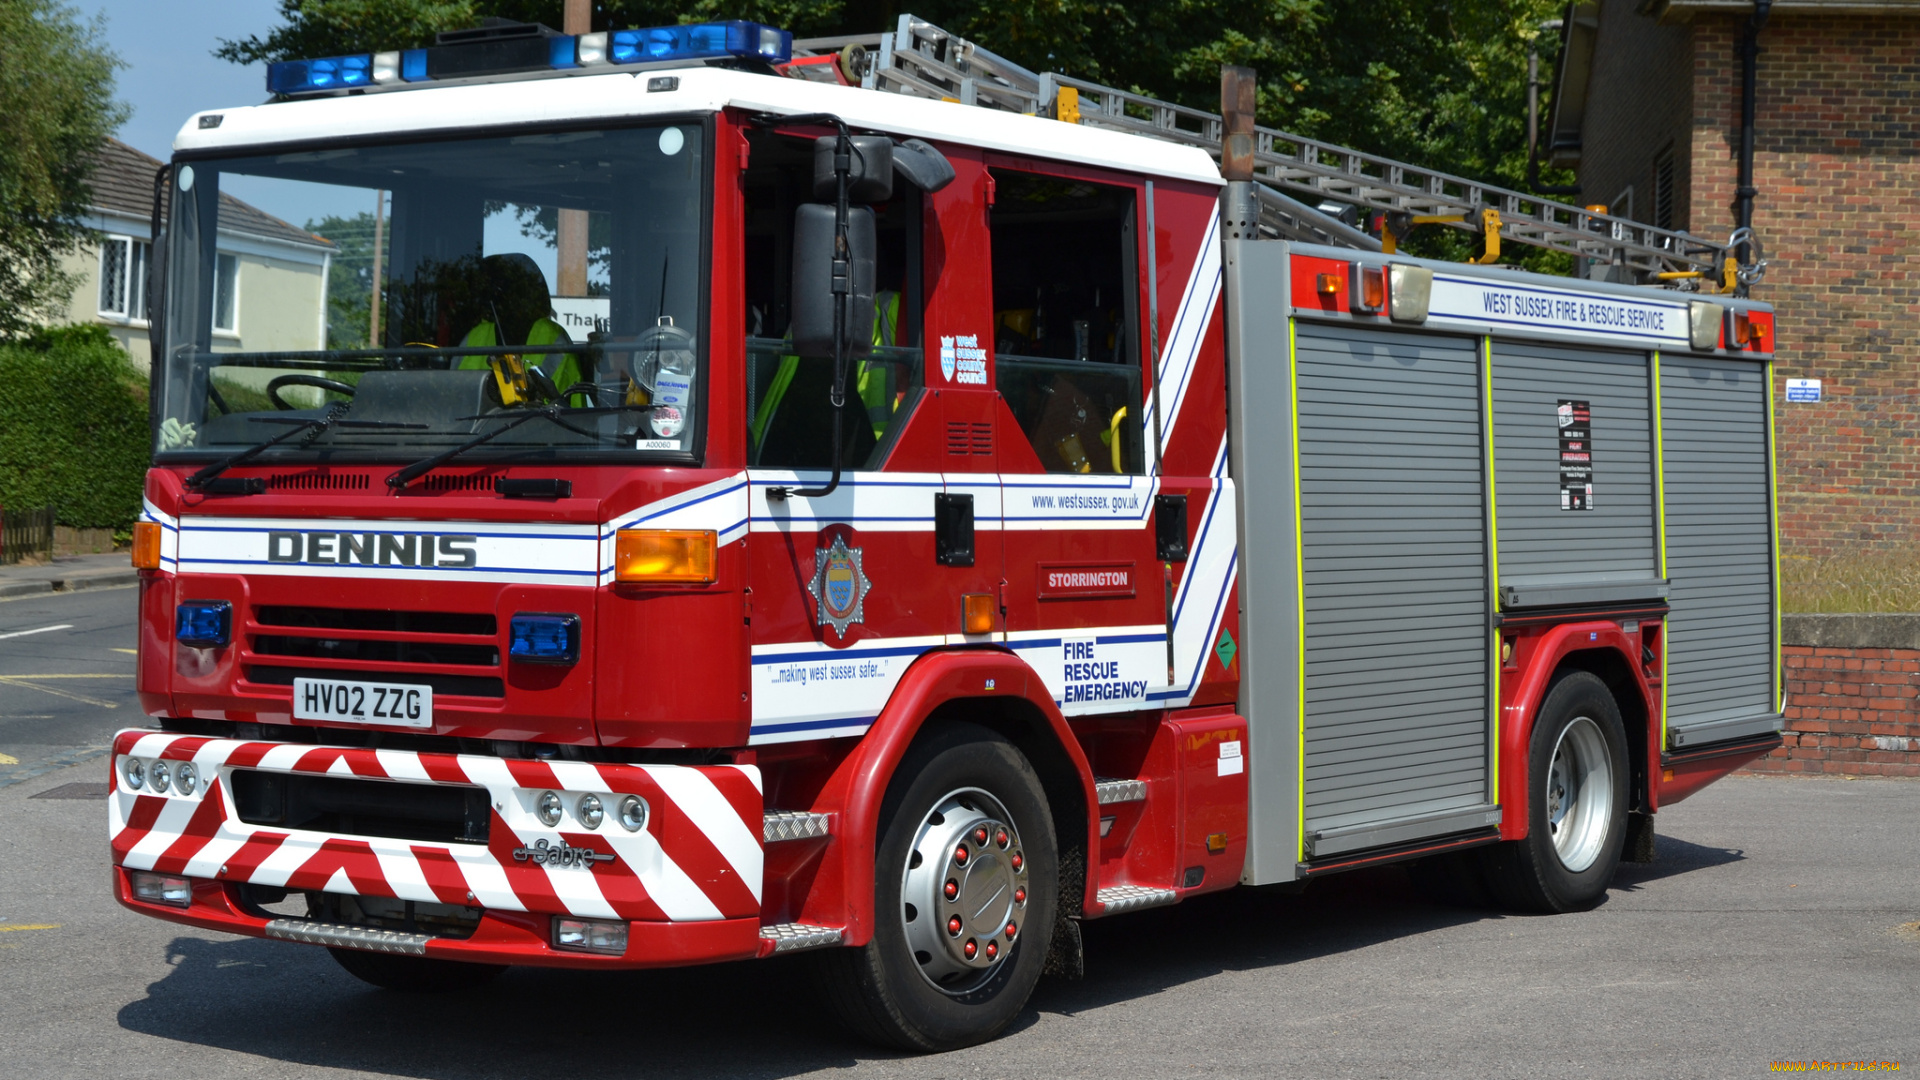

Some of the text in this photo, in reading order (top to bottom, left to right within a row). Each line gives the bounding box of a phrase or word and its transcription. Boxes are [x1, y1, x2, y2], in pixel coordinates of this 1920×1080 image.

[1483, 291, 1665, 331] WEST SUSSEX FIRE & RESCUE SERVICE
[956, 334, 978, 348] west
[956, 348, 987, 360] sussex
[646, 441, 671, 449] A00060
[268, 531, 477, 569] DENNIS
[1048, 571, 1128, 587] STORRINGTON
[1063, 641, 1094, 660] FIRE
[809, 663, 827, 681] west
[830, 663, 857, 680] sussex
[1064, 661, 1119, 681] RESCUE
[305, 683, 420, 719] HV02 ZZG
[1064, 680, 1148, 703] EMERGENCY
[533, 838, 595, 868] Sabre
